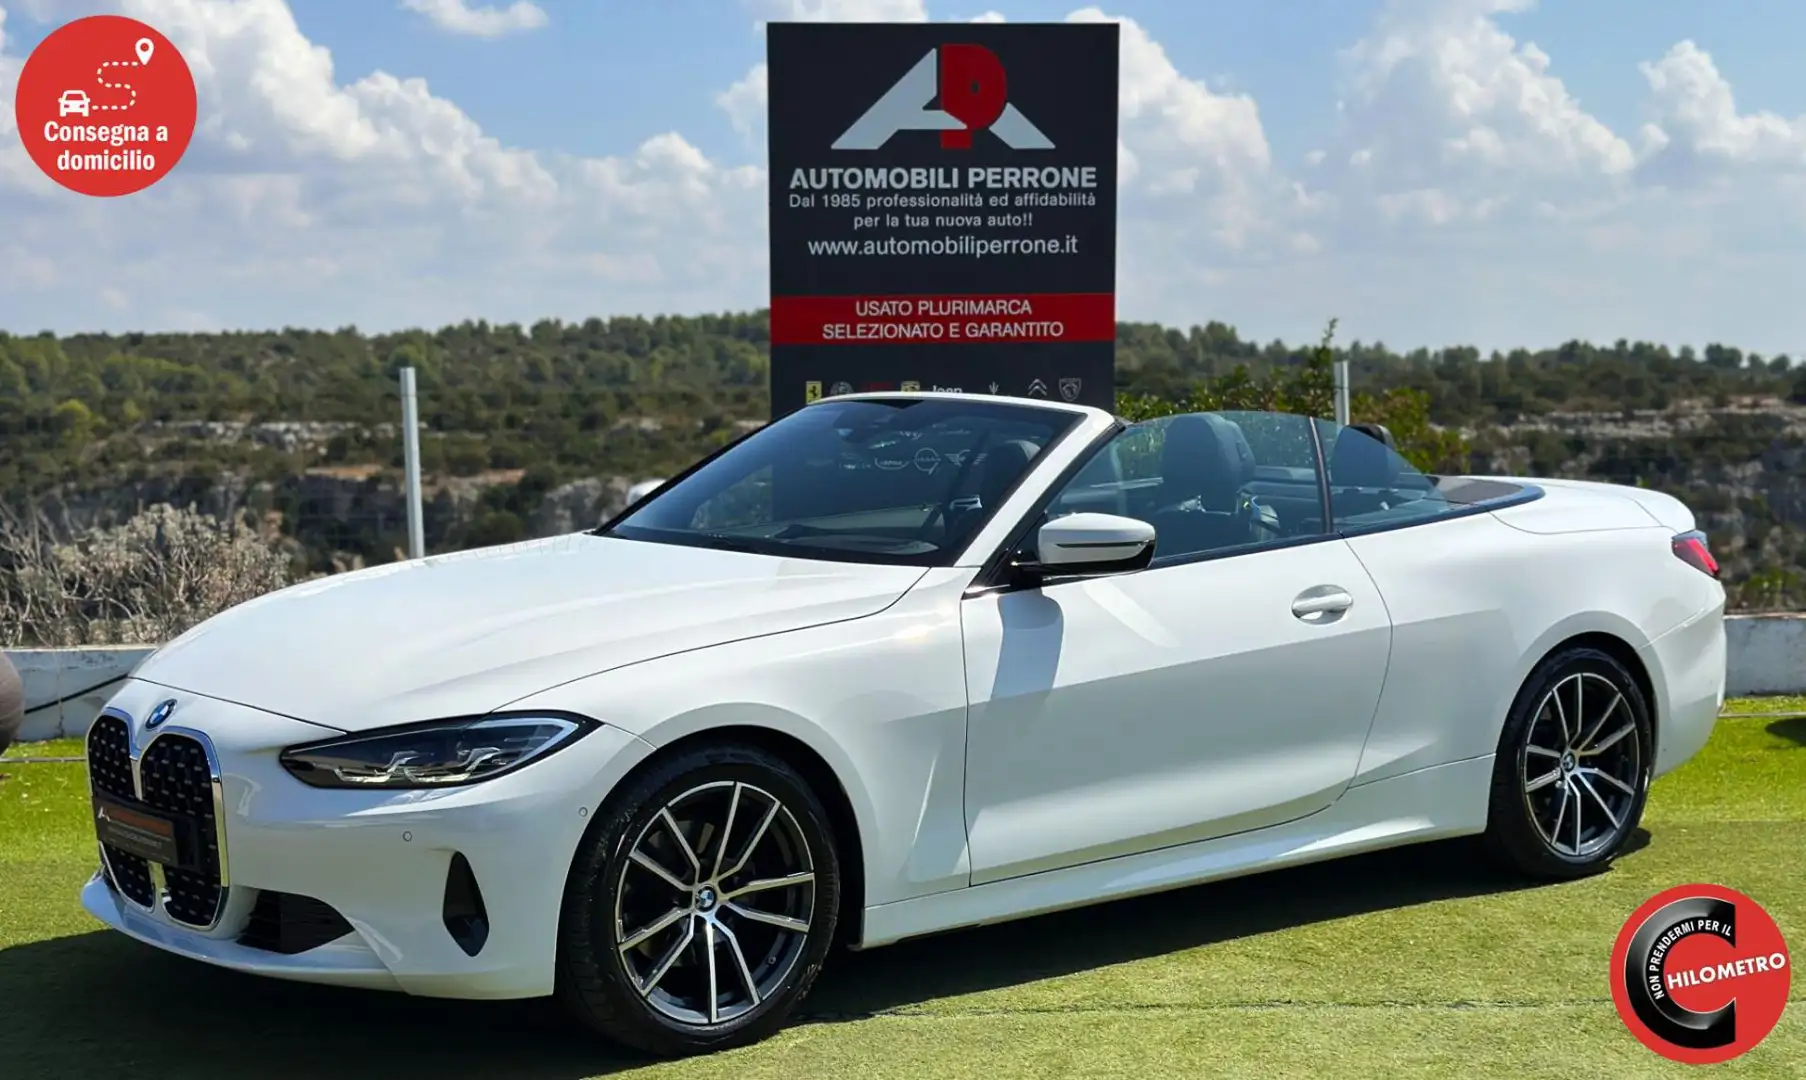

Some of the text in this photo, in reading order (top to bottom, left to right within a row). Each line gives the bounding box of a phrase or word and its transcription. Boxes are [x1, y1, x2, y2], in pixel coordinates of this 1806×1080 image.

[789, 166, 1097, 189] AUTOMOBILI PERRONE
[789, 192, 1096, 210] Dal 1985 professionalità ed affidabilità
[853, 211, 1033, 230] per la tua nuova auto!!
[807, 235, 1078, 258] www.automobiliperrone.it
[855, 299, 1033, 317] USATO PLURIMARCA
[822, 321, 1064, 340] SELEZIONATO E GARANTITO
